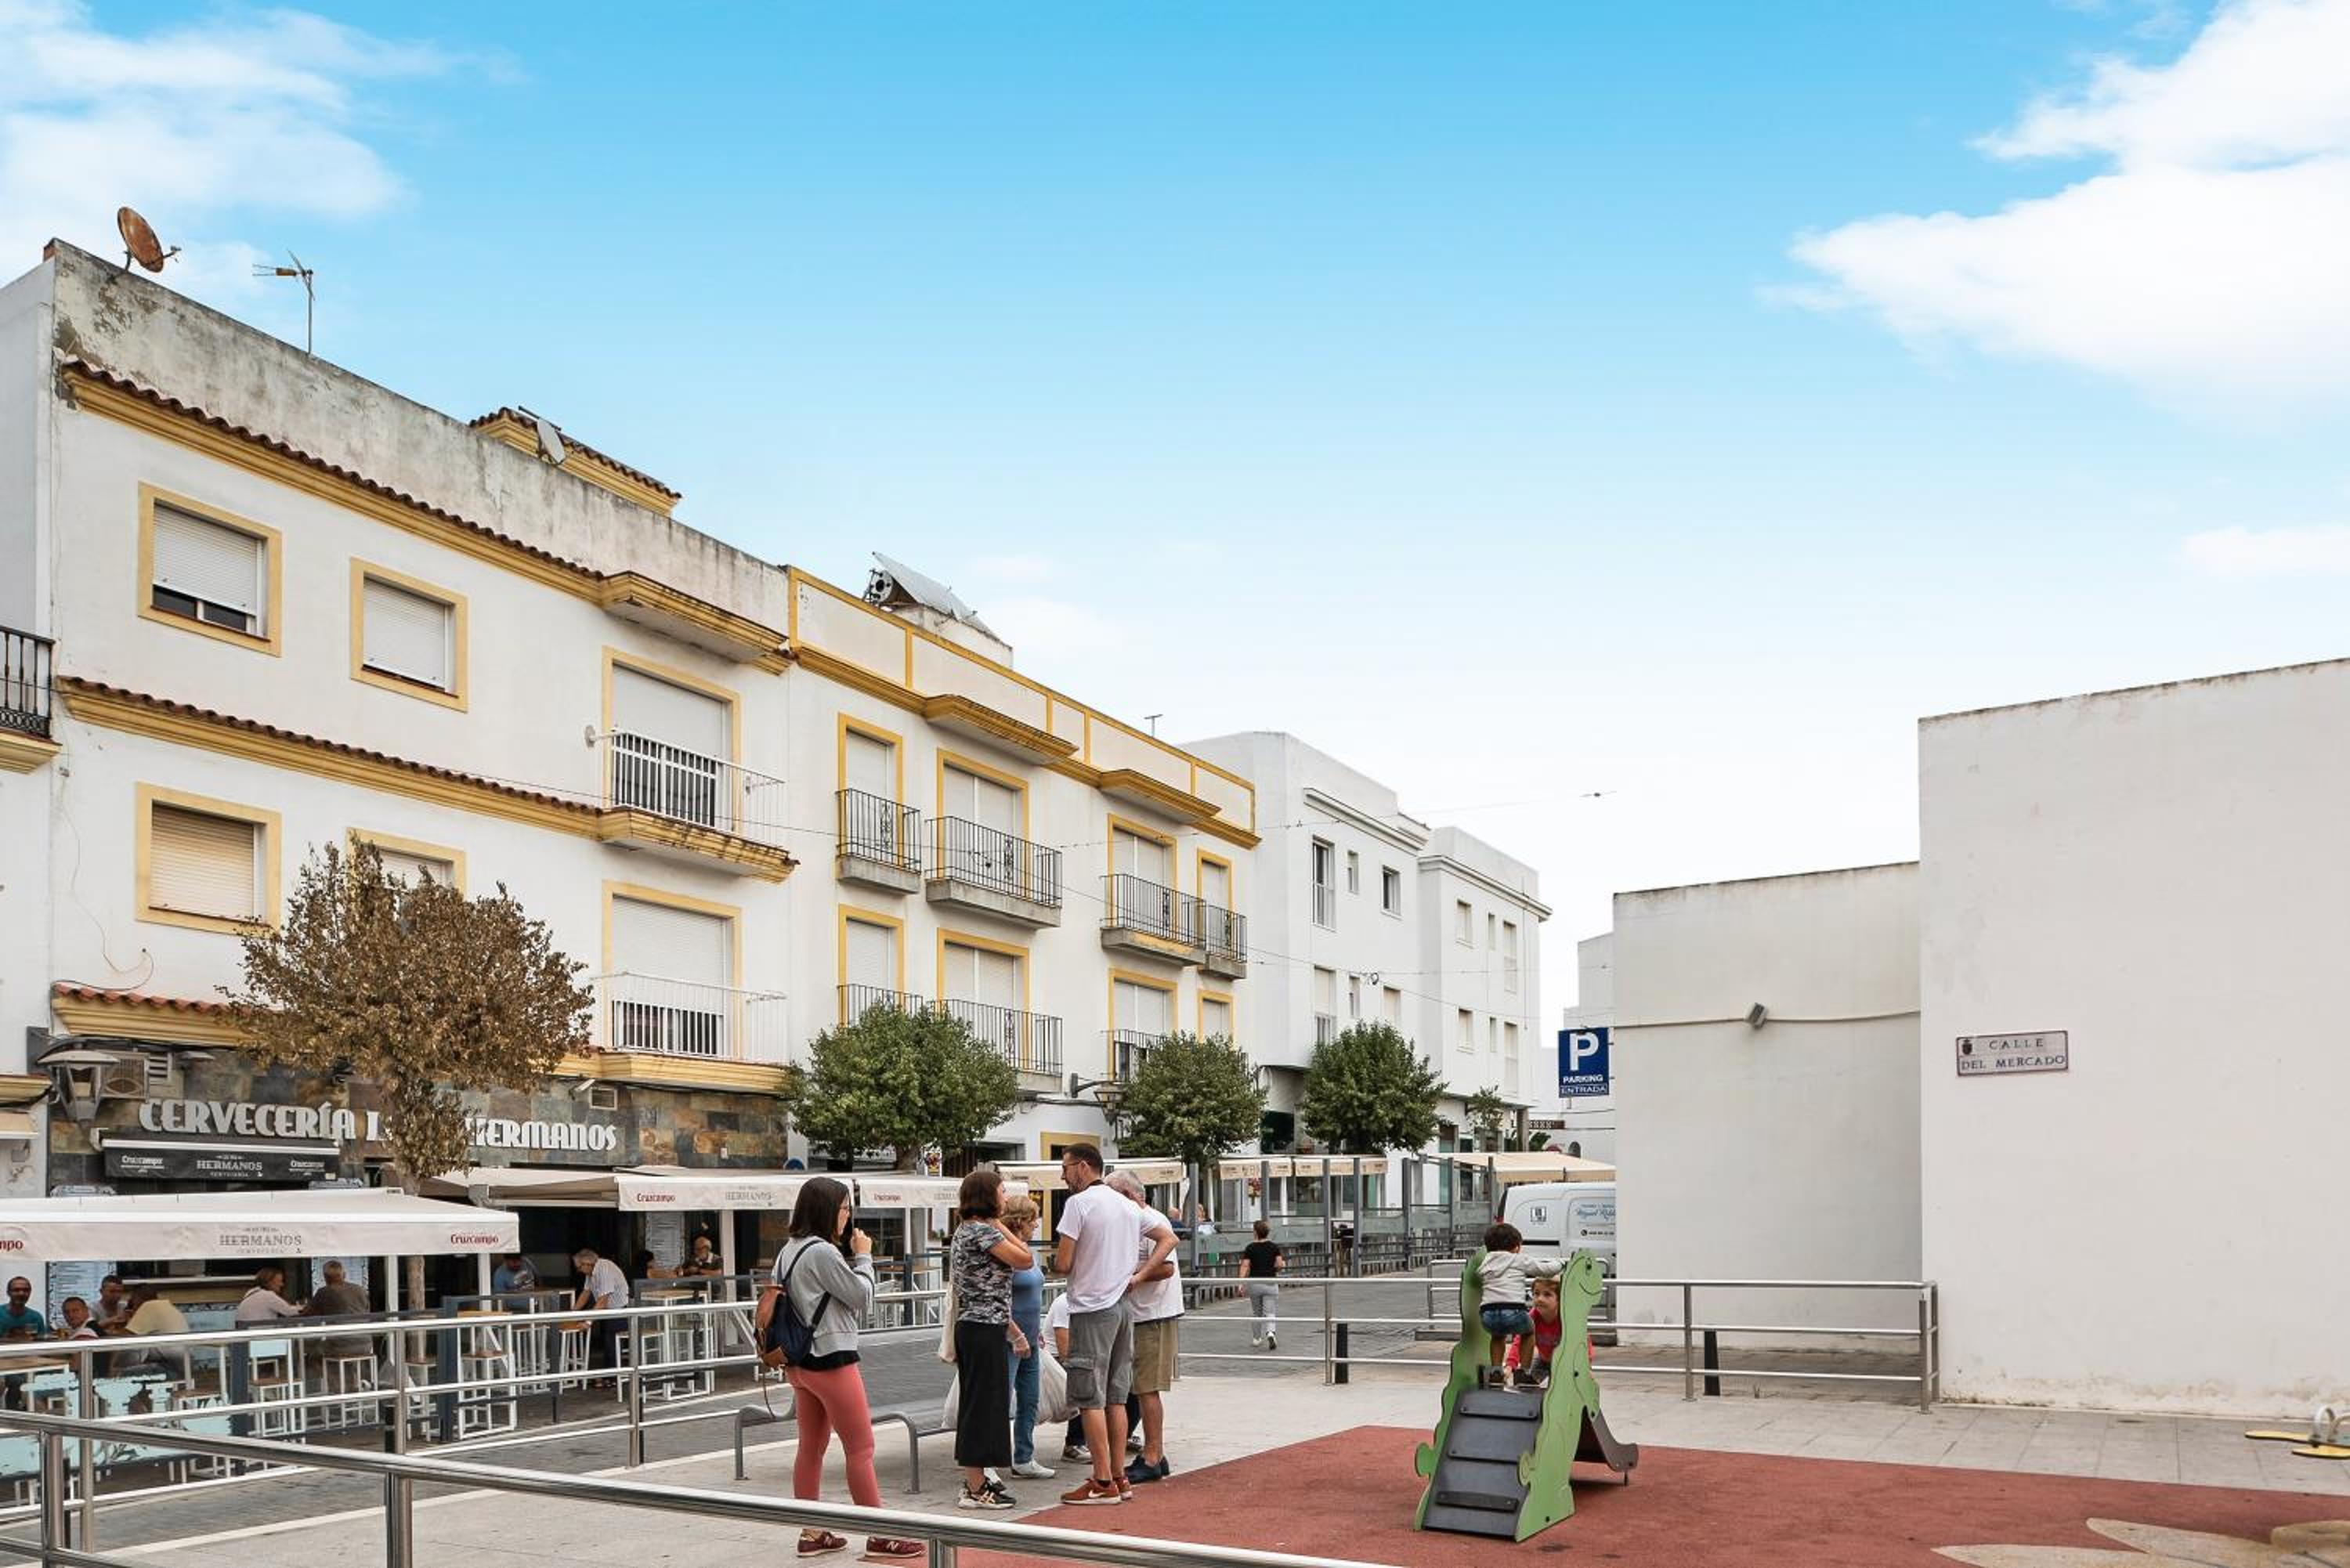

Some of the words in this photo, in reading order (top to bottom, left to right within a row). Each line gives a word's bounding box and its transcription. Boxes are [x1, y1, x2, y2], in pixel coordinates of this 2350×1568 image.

[1989, 1039, 2044, 1050] CALLE
[1569, 1032, 1599, 1071] P
[1961, 1060, 1987, 1070] DEL
[1995, 1055, 2065, 1068] MERCADO
[1563, 1074, 1603, 1084] PARKING
[1561, 1086, 1606, 1094] ENTRADA
[139, 1099, 356, 1140] CERVECERÍA
[197, 1160, 263, 1171] HERMANOS
[219, 1235, 302, 1246] HERMANOS
[450, 1234, 499, 1245] Cruzcampo
